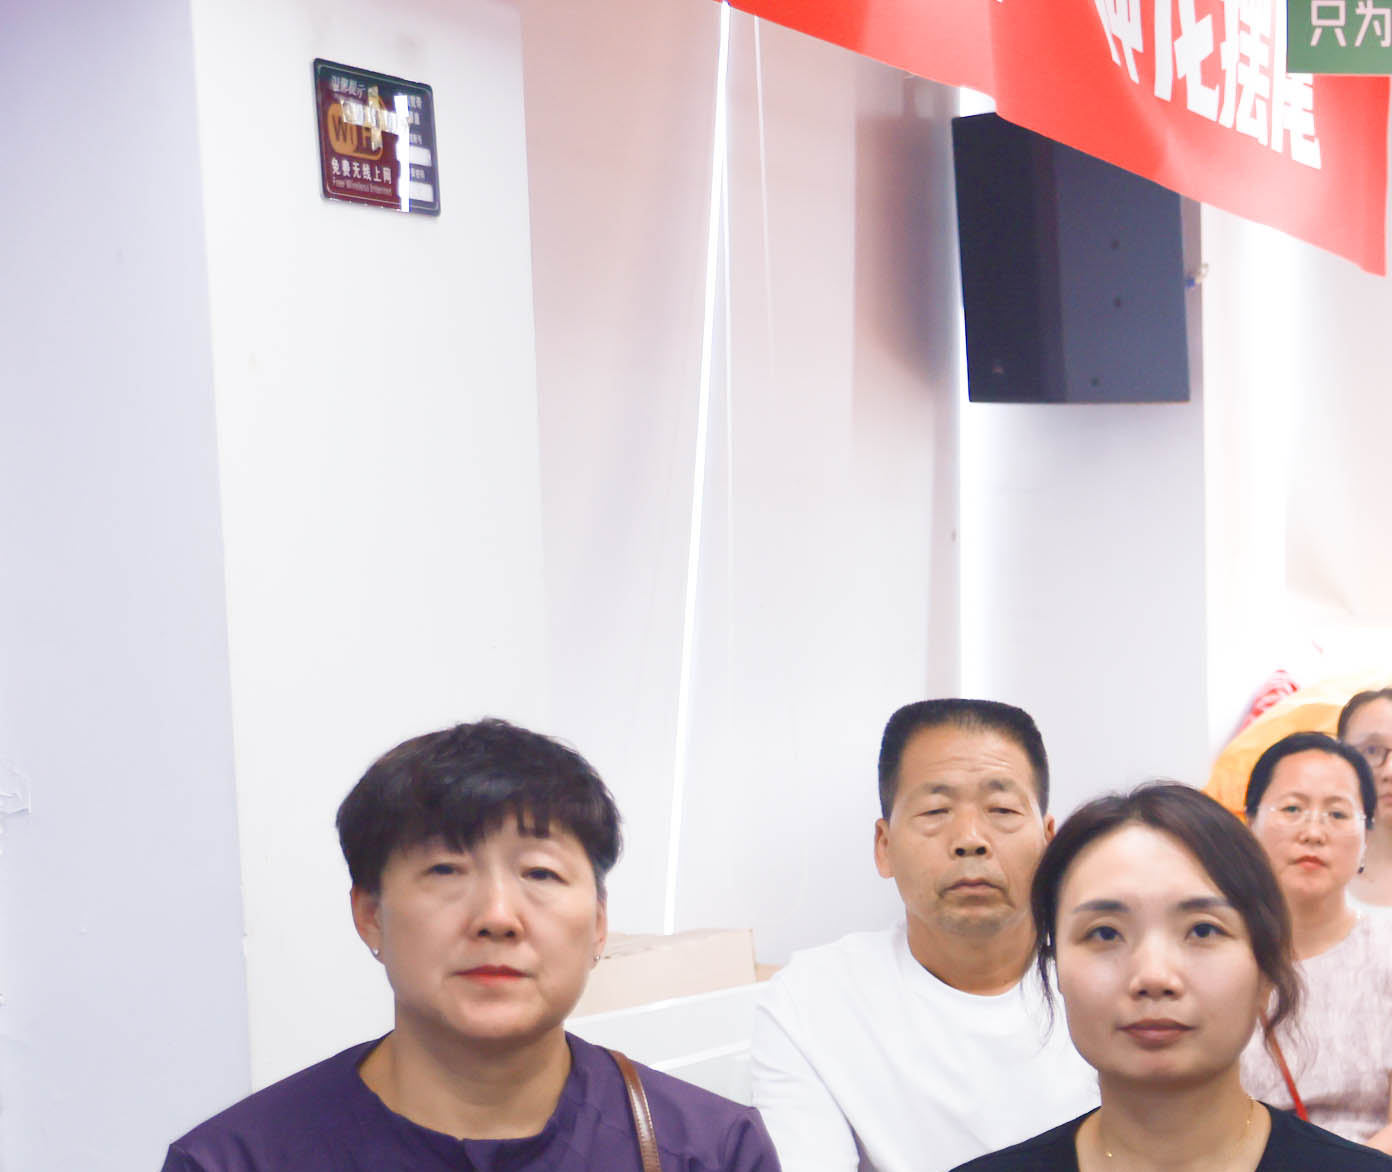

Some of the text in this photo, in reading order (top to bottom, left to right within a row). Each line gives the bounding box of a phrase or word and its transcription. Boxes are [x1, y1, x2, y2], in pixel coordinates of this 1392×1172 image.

[331, 157, 392, 184] 免费无线上网
